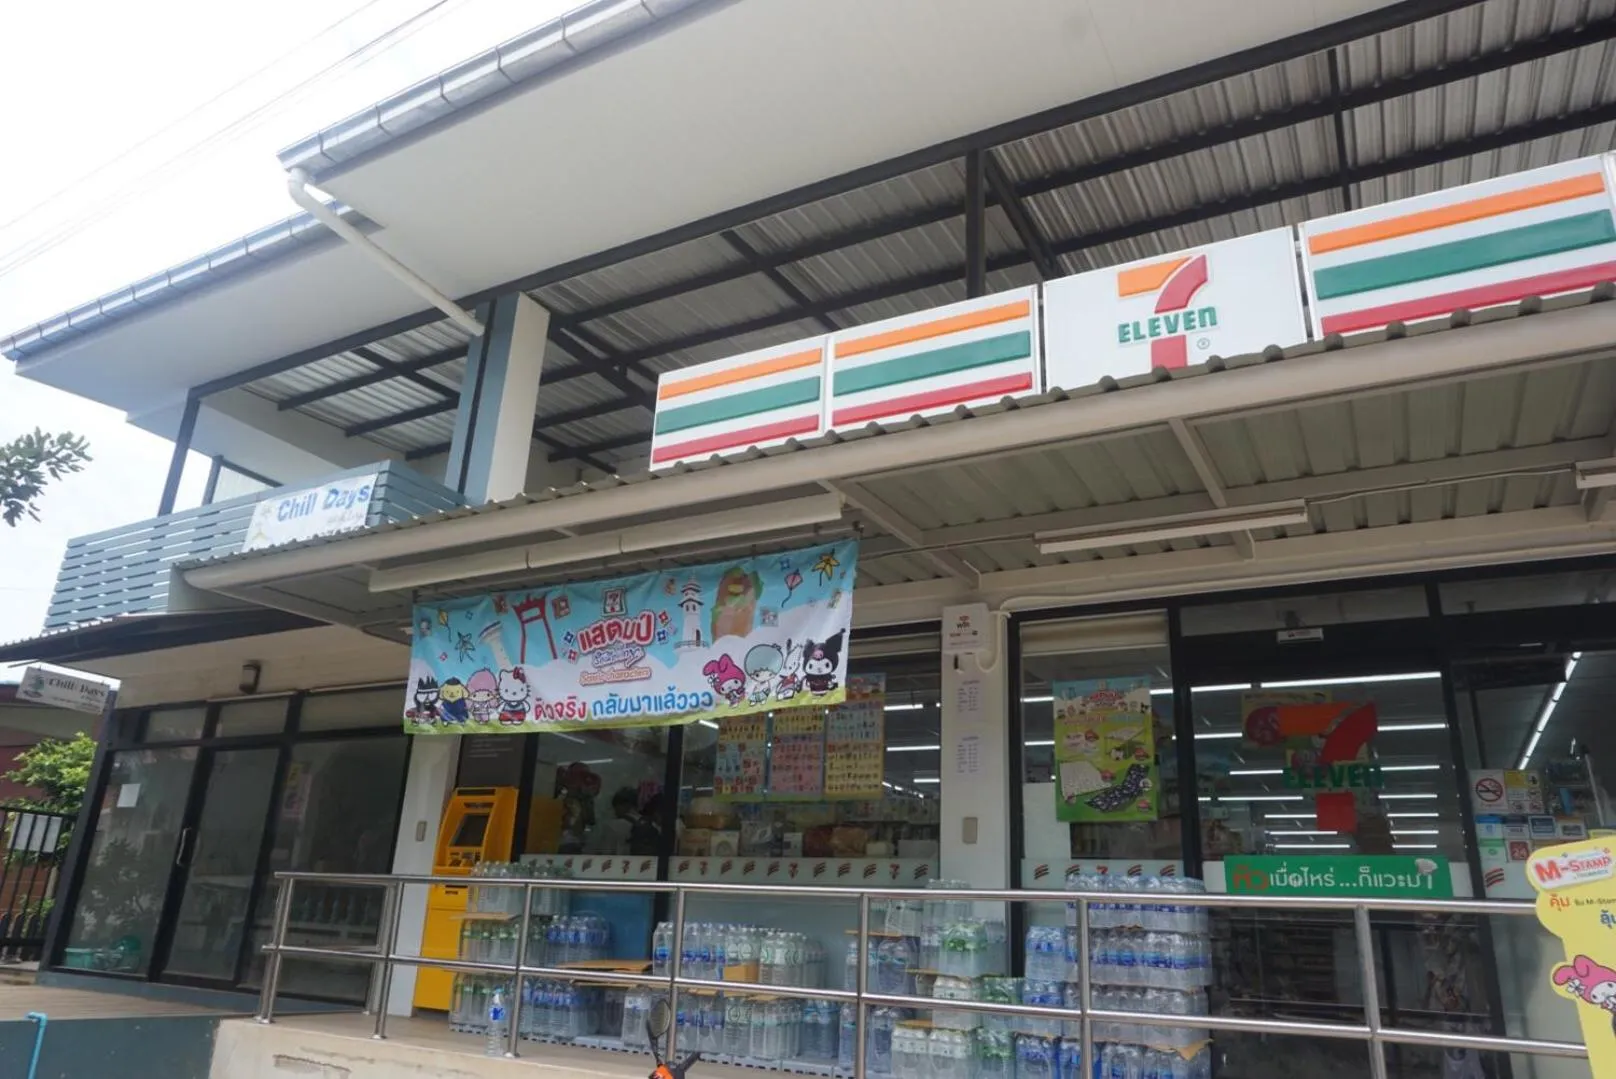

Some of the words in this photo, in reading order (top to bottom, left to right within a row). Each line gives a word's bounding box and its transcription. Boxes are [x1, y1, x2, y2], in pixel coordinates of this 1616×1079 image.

[277, 493, 317, 522] Chill
[323, 485, 370, 509] Days
[48, 678, 76, 691] Chill
[592, 685, 713, 718] กลับมาแล้ววว
